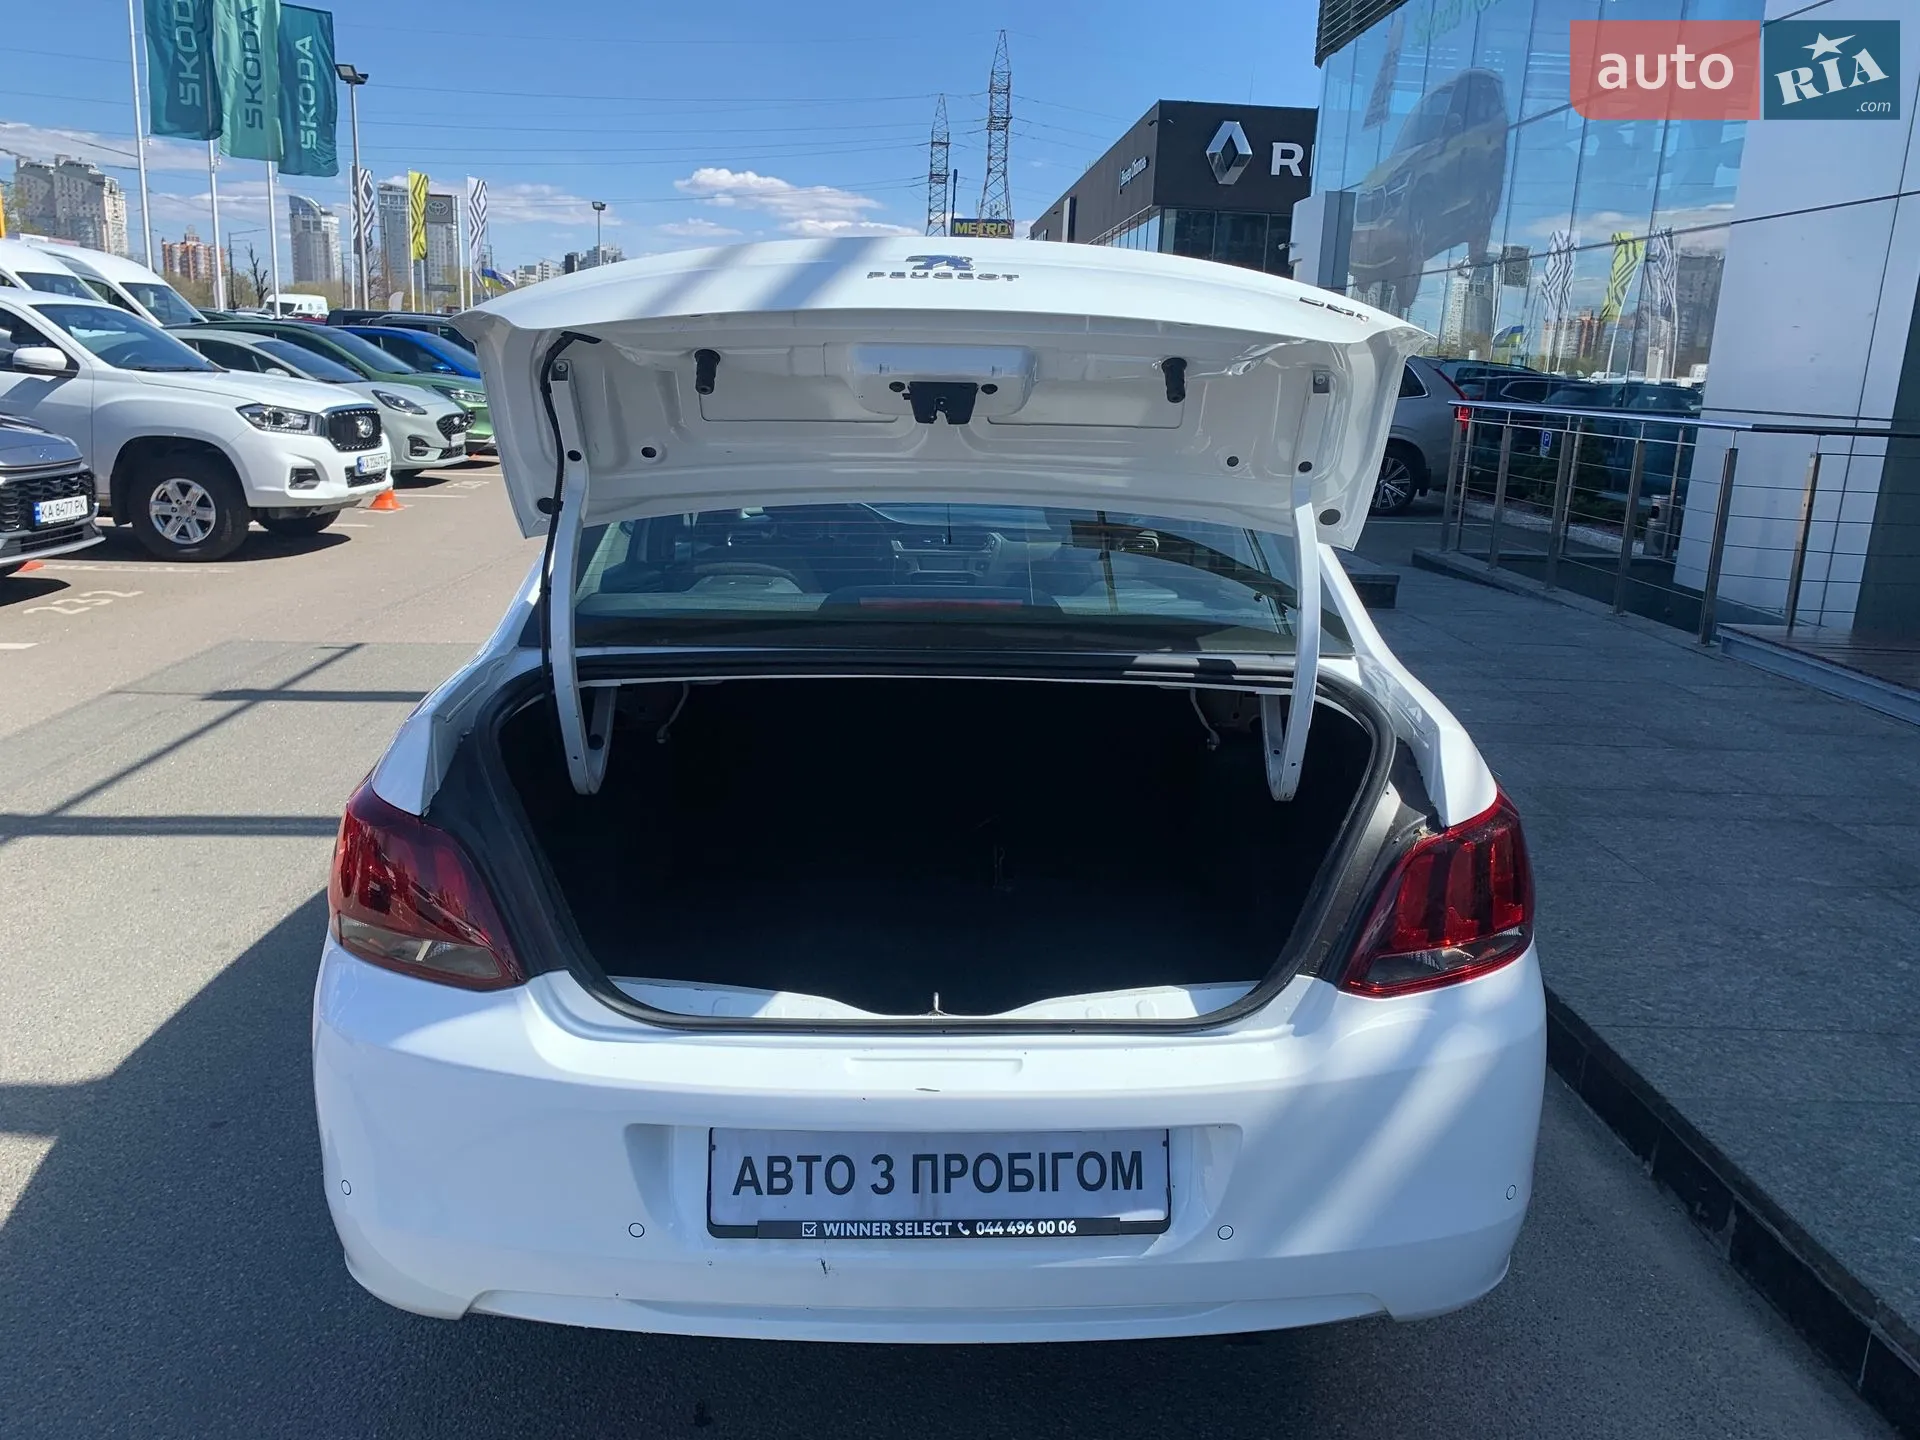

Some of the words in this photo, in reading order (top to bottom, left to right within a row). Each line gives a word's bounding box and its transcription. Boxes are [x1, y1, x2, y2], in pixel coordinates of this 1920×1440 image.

[1270, 142, 1315, 177] R
[954, 222, 1009, 235] METRO
[866, 271, 1020, 282] PEUGEOT
[732, 1154, 856, 1196] АВТО
[870, 1154, 895, 1195] З
[912, 1151, 1143, 1194] ПРОБІГОМ
[822, 1222, 892, 1237] WINNER
[895, 1222, 952, 1236] SELECT
[976, 1221, 1004, 1235] 044
[1006, 1220, 1034, 1235] 496
[1037, 1220, 1056, 1235] 00
[1058, 1220, 1077, 1234] 06
